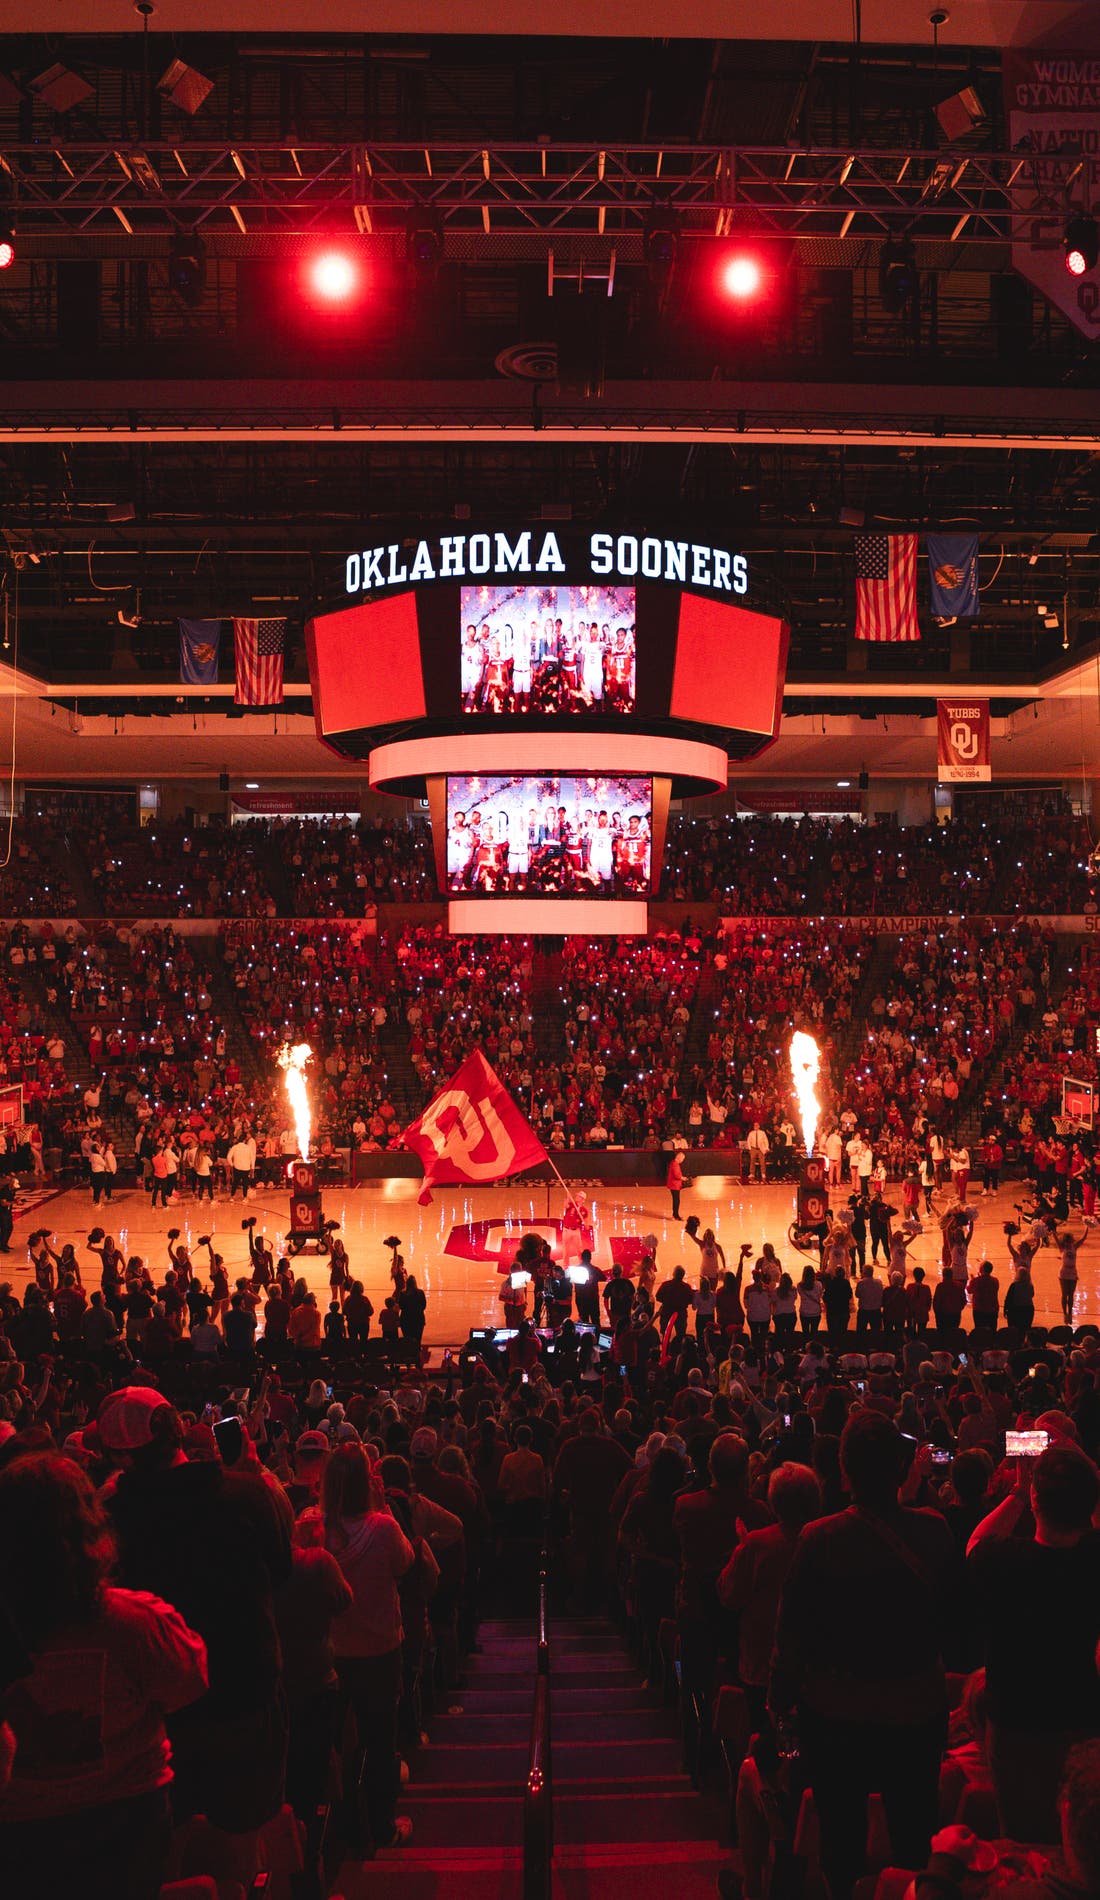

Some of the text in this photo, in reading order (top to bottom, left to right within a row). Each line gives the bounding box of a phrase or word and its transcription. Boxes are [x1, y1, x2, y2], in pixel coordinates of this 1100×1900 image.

[345, 531, 748, 595] OKLAHOMA SOONERS
[947, 708, 980, 719] TUBBS
[951, 723, 978, 758] OU
[859, 918, 940, 932] CHAMPION
[420, 1090, 516, 1181] OU
[296, 1203, 313, 1226] OU
[807, 1198, 823, 1219] OU
